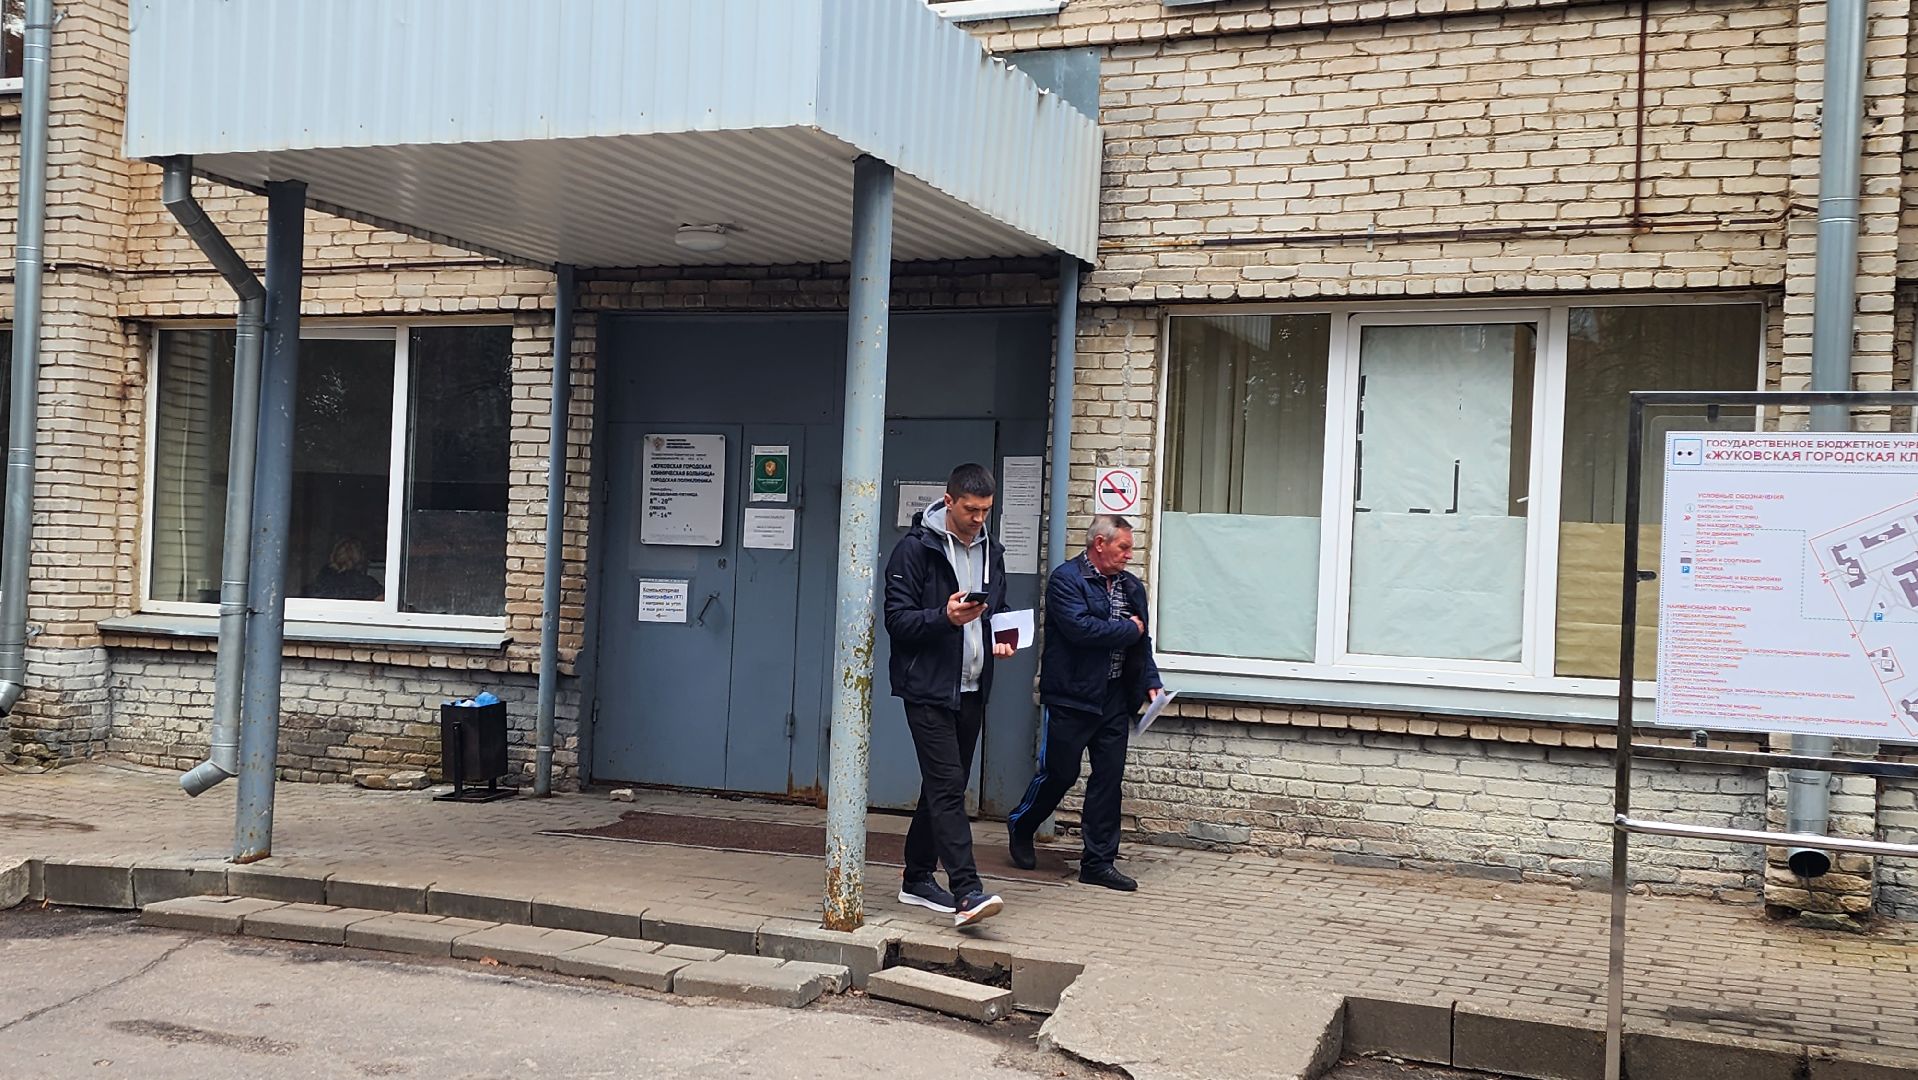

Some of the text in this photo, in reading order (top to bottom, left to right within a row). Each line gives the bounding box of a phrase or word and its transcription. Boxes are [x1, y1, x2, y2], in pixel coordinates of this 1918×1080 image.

[1706, 439, 1814, 449] ГОСУДАРСТВЕННОЕ
[1816, 440, 1890, 449] БЮДЖЕТНОЕ
[1705, 450, 1801, 461] «ЖУКОВСКАЯ
[1805, 451, 1895, 463] ГОРОДСКАЯ
